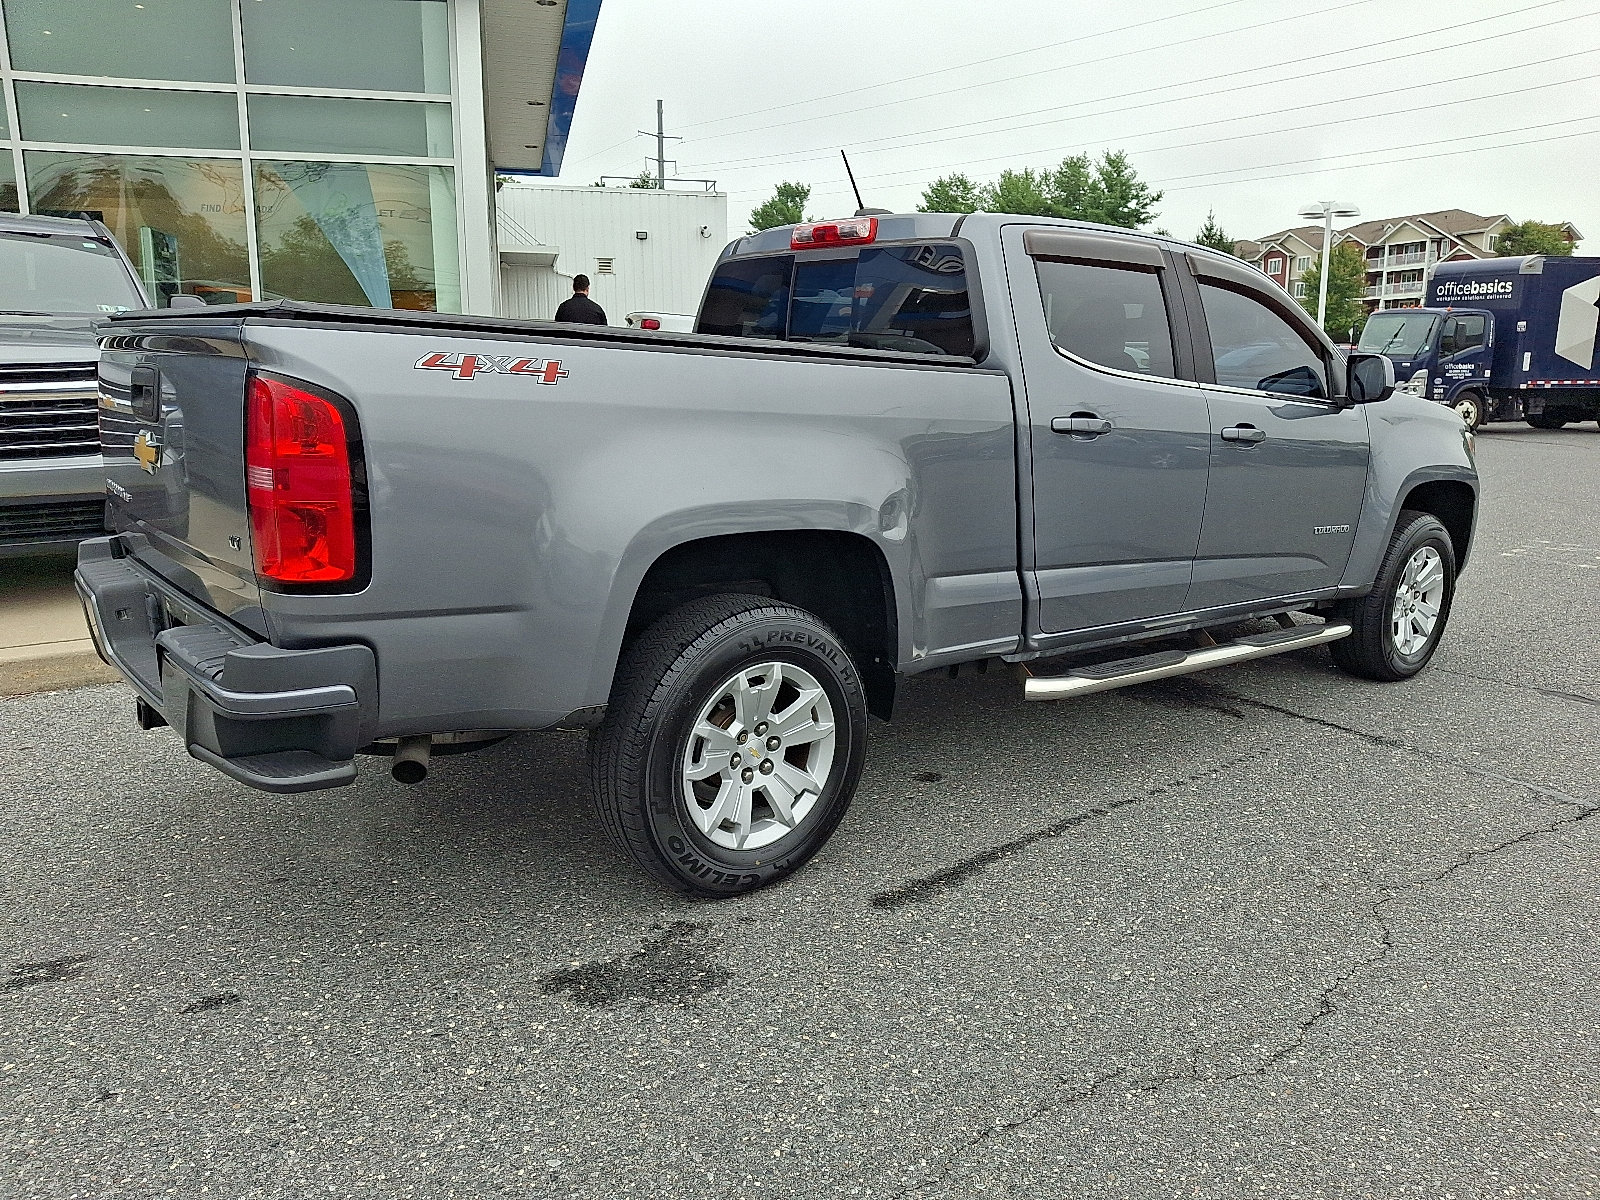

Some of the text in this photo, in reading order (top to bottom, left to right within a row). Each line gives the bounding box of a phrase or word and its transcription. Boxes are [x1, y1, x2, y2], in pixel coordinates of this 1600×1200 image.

[200, 203, 222, 213] FIND
[1436, 279, 1513, 296] officebasics
[766, 629, 840, 667] PREVAIL
[667, 835, 761, 886] CELIMO
